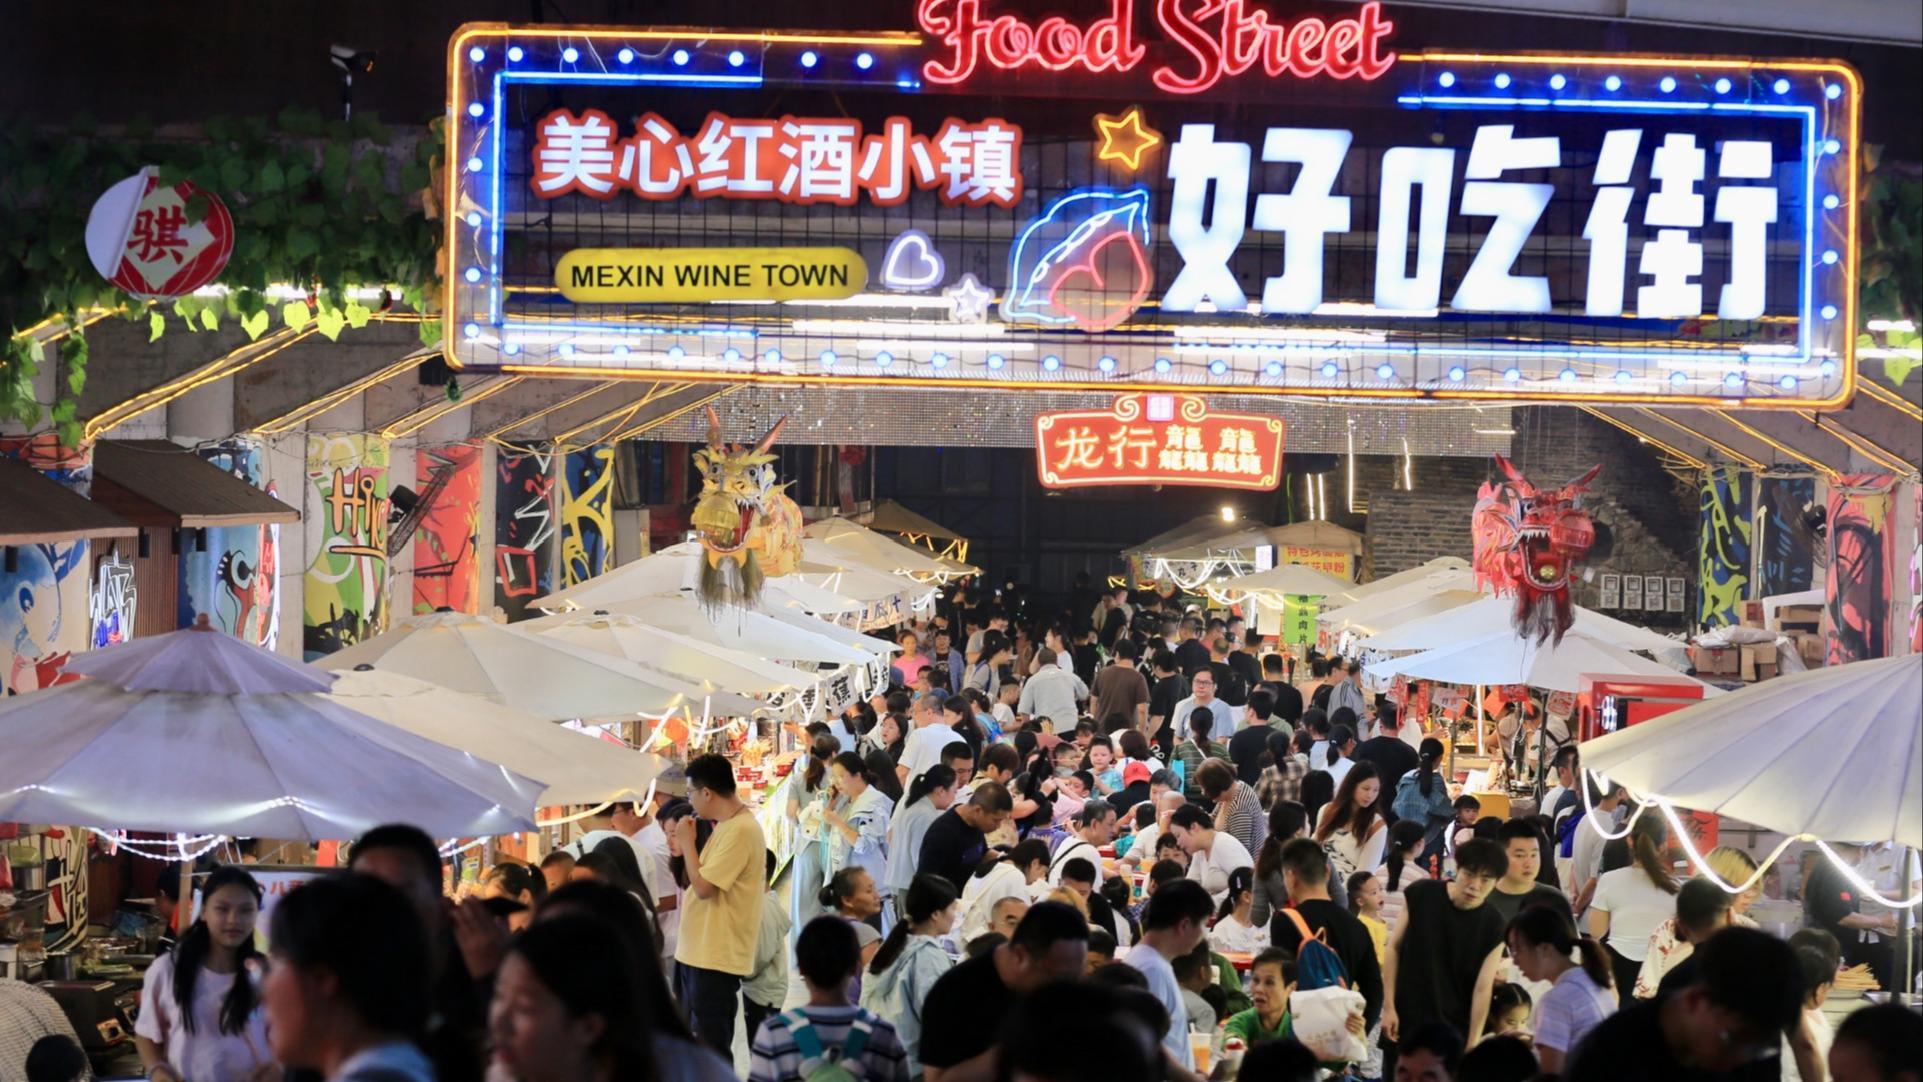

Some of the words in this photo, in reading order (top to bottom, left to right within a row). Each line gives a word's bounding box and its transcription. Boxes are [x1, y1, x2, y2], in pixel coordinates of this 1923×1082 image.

[918, 0, 1145, 84] Food
[1153, 0, 1396, 94] Street
[538, 116, 1015, 202] 美心红酒小镇
[127, 205, 188, 265] 骐
[1161, 123, 1778, 319] 好吃街
[571, 265, 664, 288] MEXIN
[675, 265, 751, 287] WINE
[761, 264, 849, 287] TOWN
